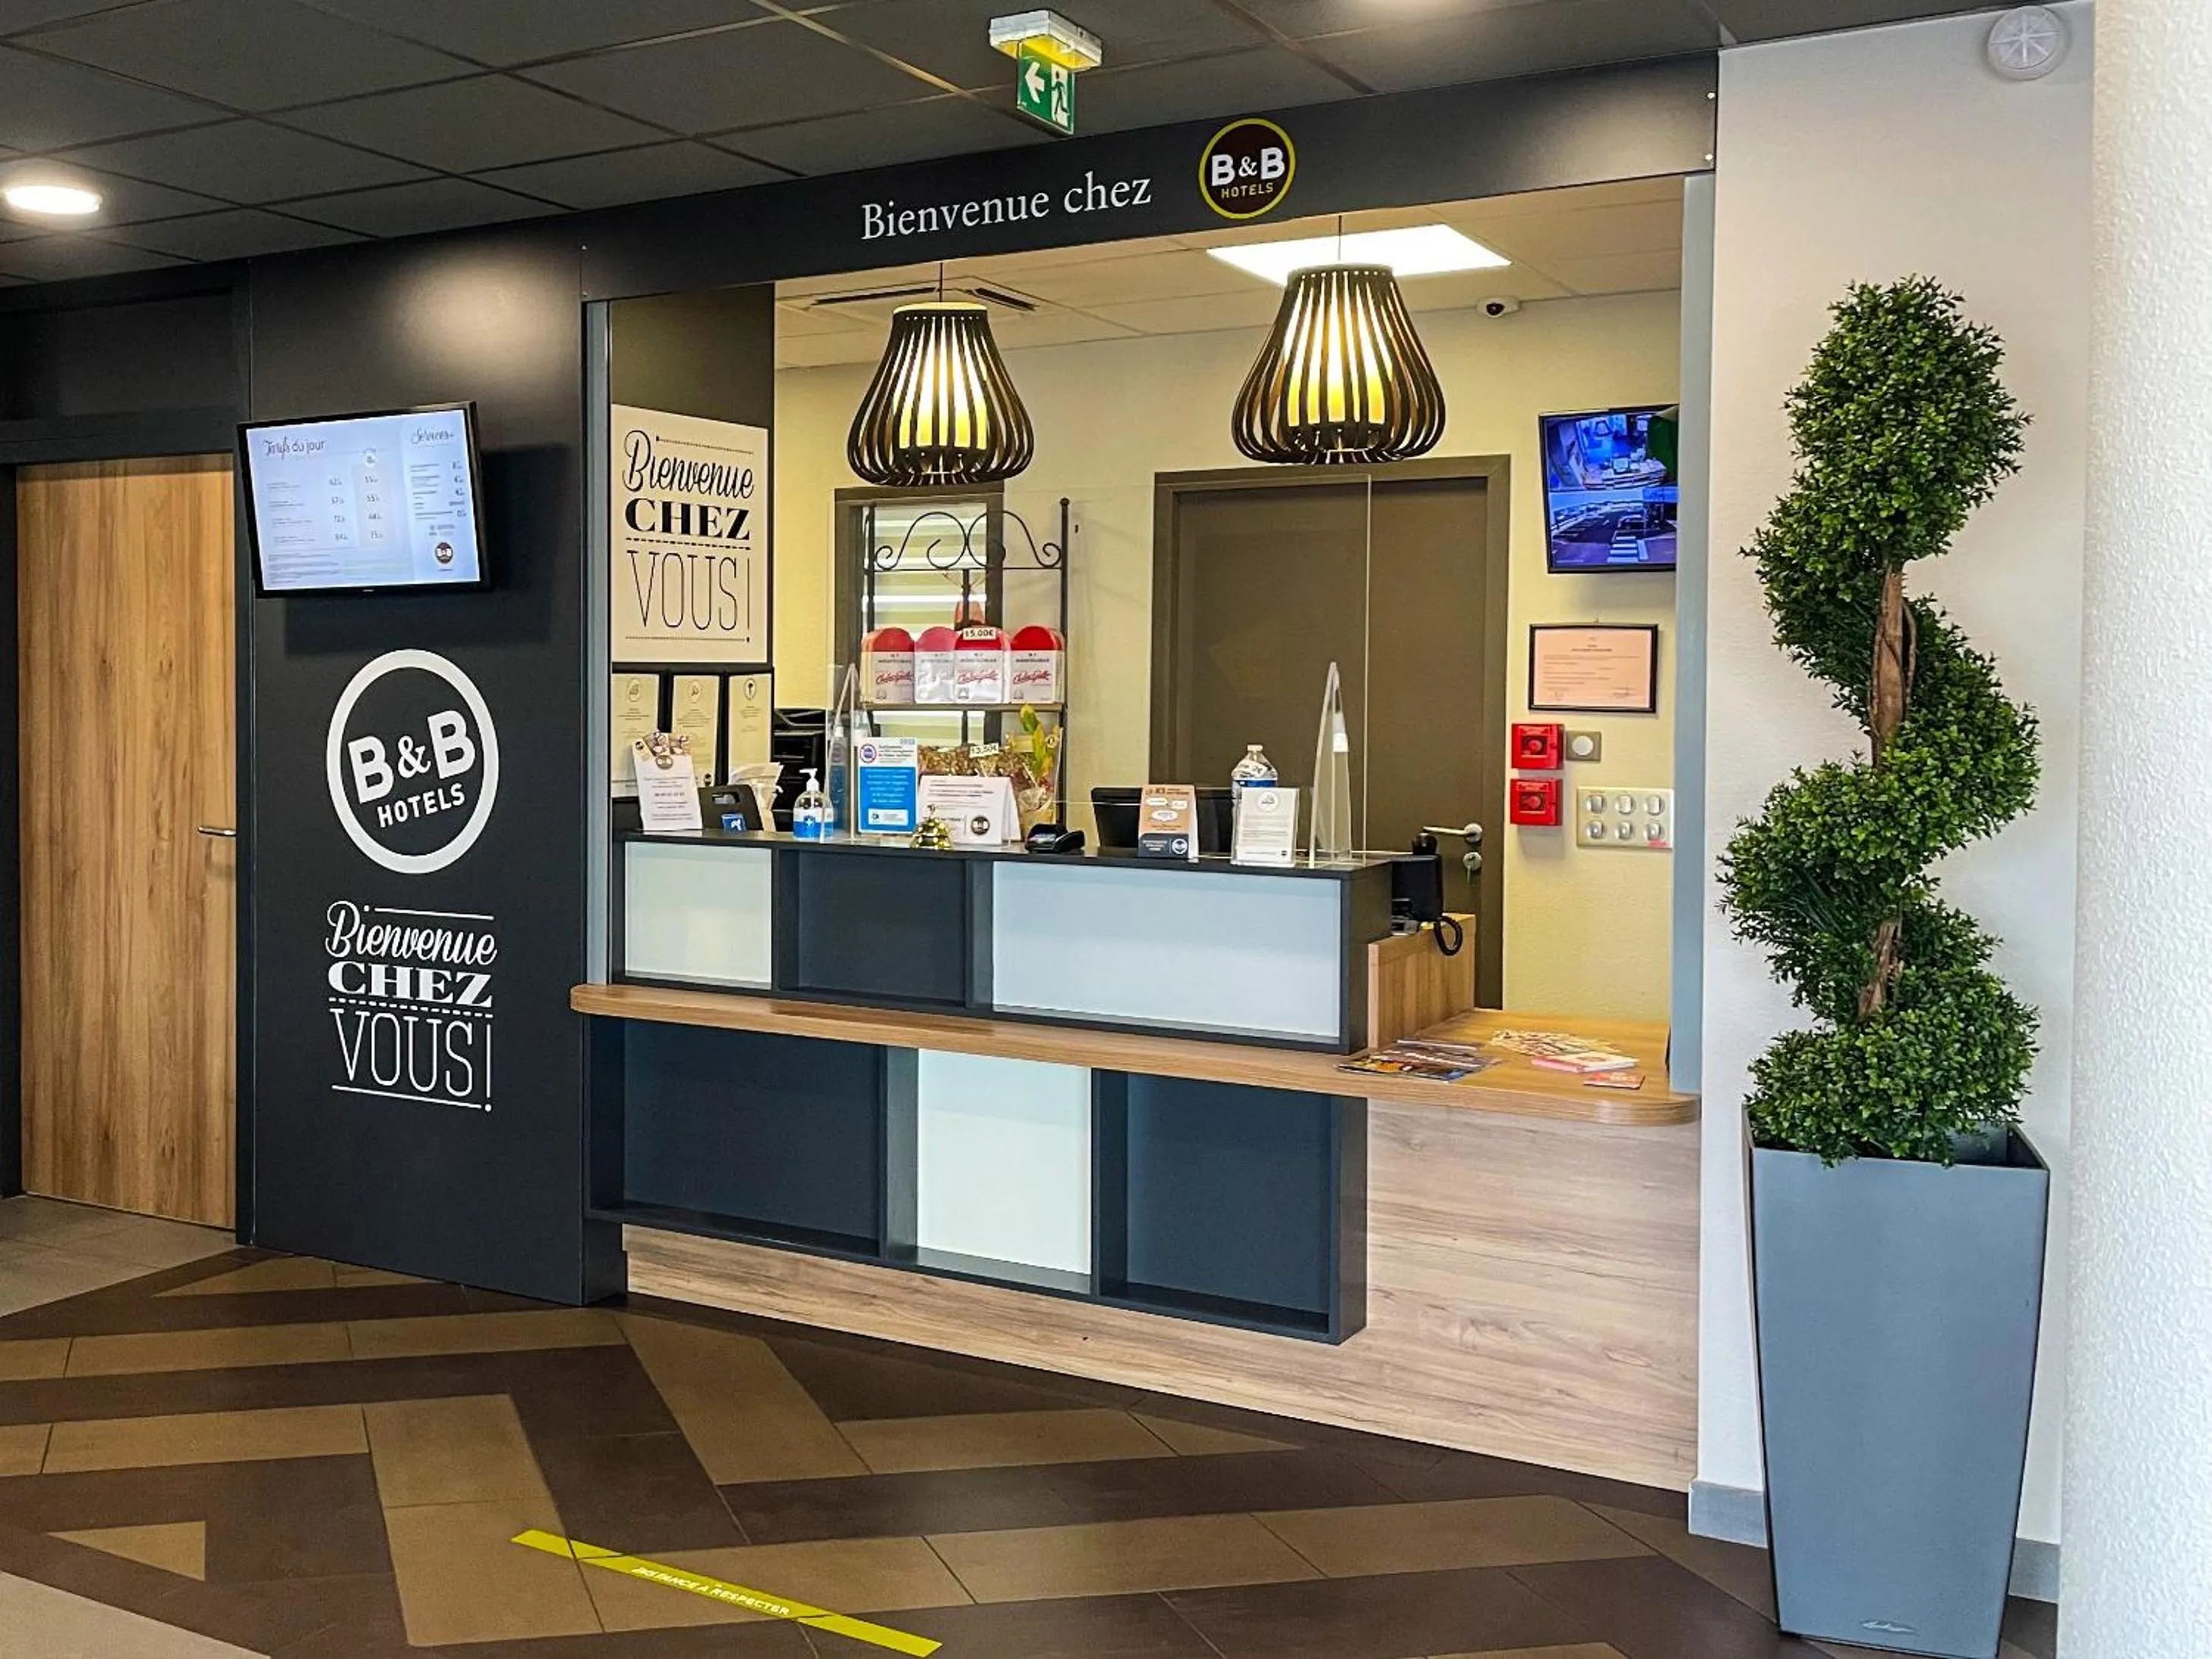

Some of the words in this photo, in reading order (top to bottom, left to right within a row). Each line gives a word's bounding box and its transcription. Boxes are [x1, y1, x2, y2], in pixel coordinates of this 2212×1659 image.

[1211, 147, 1286, 187] B&B
[1220, 182, 1274, 199] HOTELS
[860, 192, 1049, 240] Bienvenue
[1064, 171, 1152, 213] chez
[622, 430, 755, 499] Bienvenue
[625, 497, 750, 541] CHEZ
[348, 709, 476, 805] B&B
[377, 783, 465, 828] HOTELS
[325, 900, 498, 966] Bienvenue
[327, 960, 493, 1008] CHEZ
